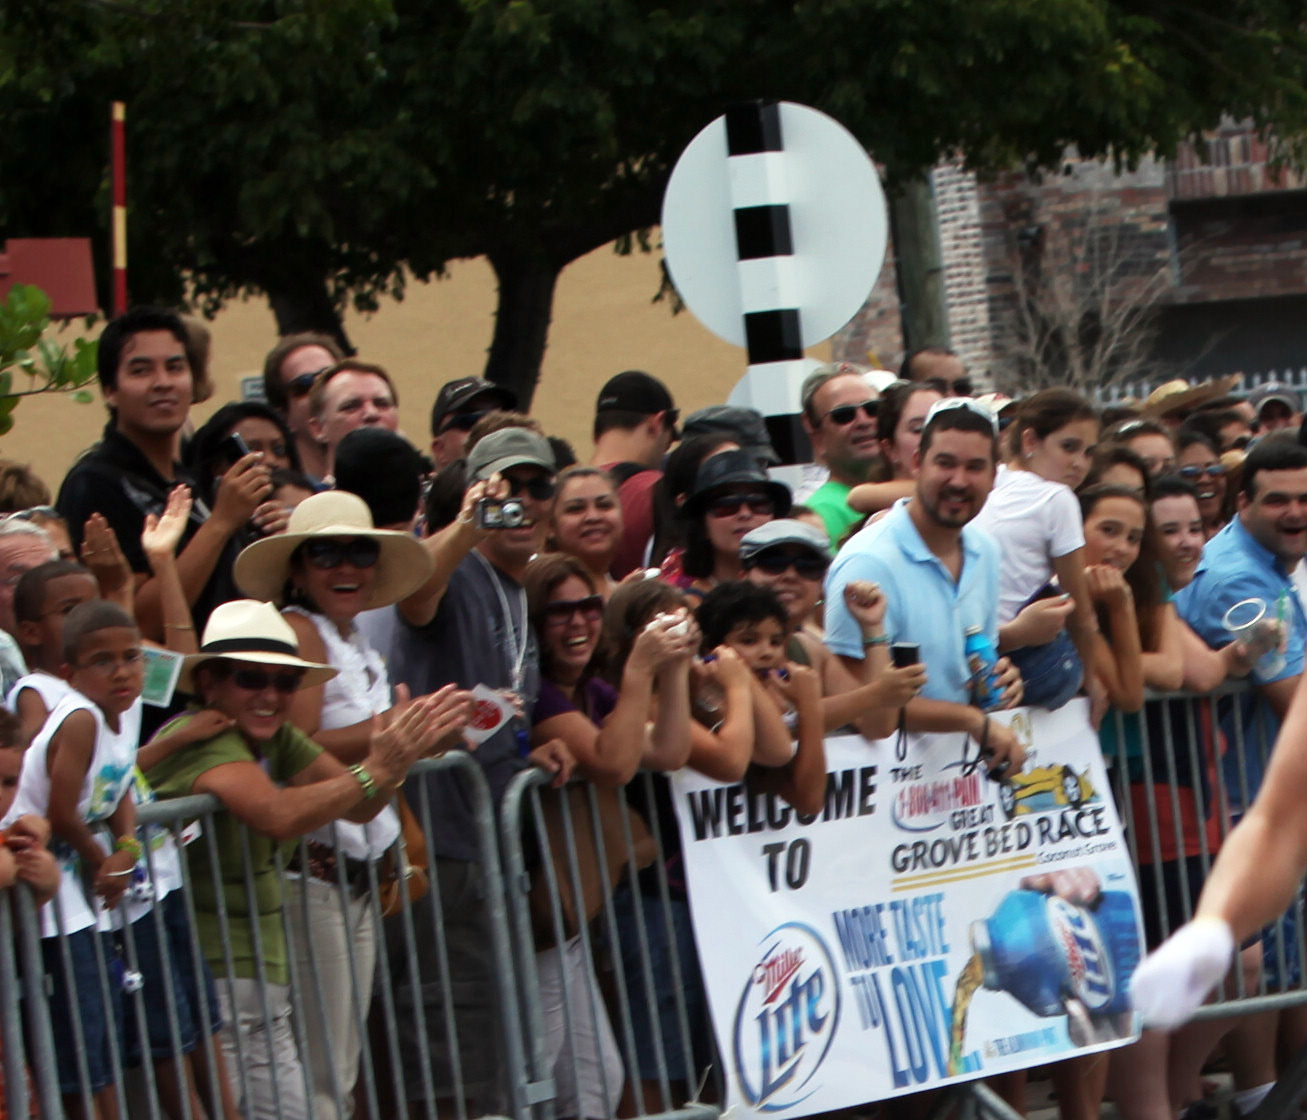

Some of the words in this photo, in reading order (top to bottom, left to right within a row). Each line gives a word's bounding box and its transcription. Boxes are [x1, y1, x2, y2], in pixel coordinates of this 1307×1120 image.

[890, 764, 923, 783] THE
[891, 831, 981, 873] GROVE
[983, 821, 1032, 857] BED
[1036, 805, 1111, 845] RACE
[951, 804, 995, 832] GREAT
[762, 836, 812, 892] TO
[832, 903, 894, 973] MORE
[889, 892, 950, 962] TASTE
[872, 959, 983, 1090] LOVE
